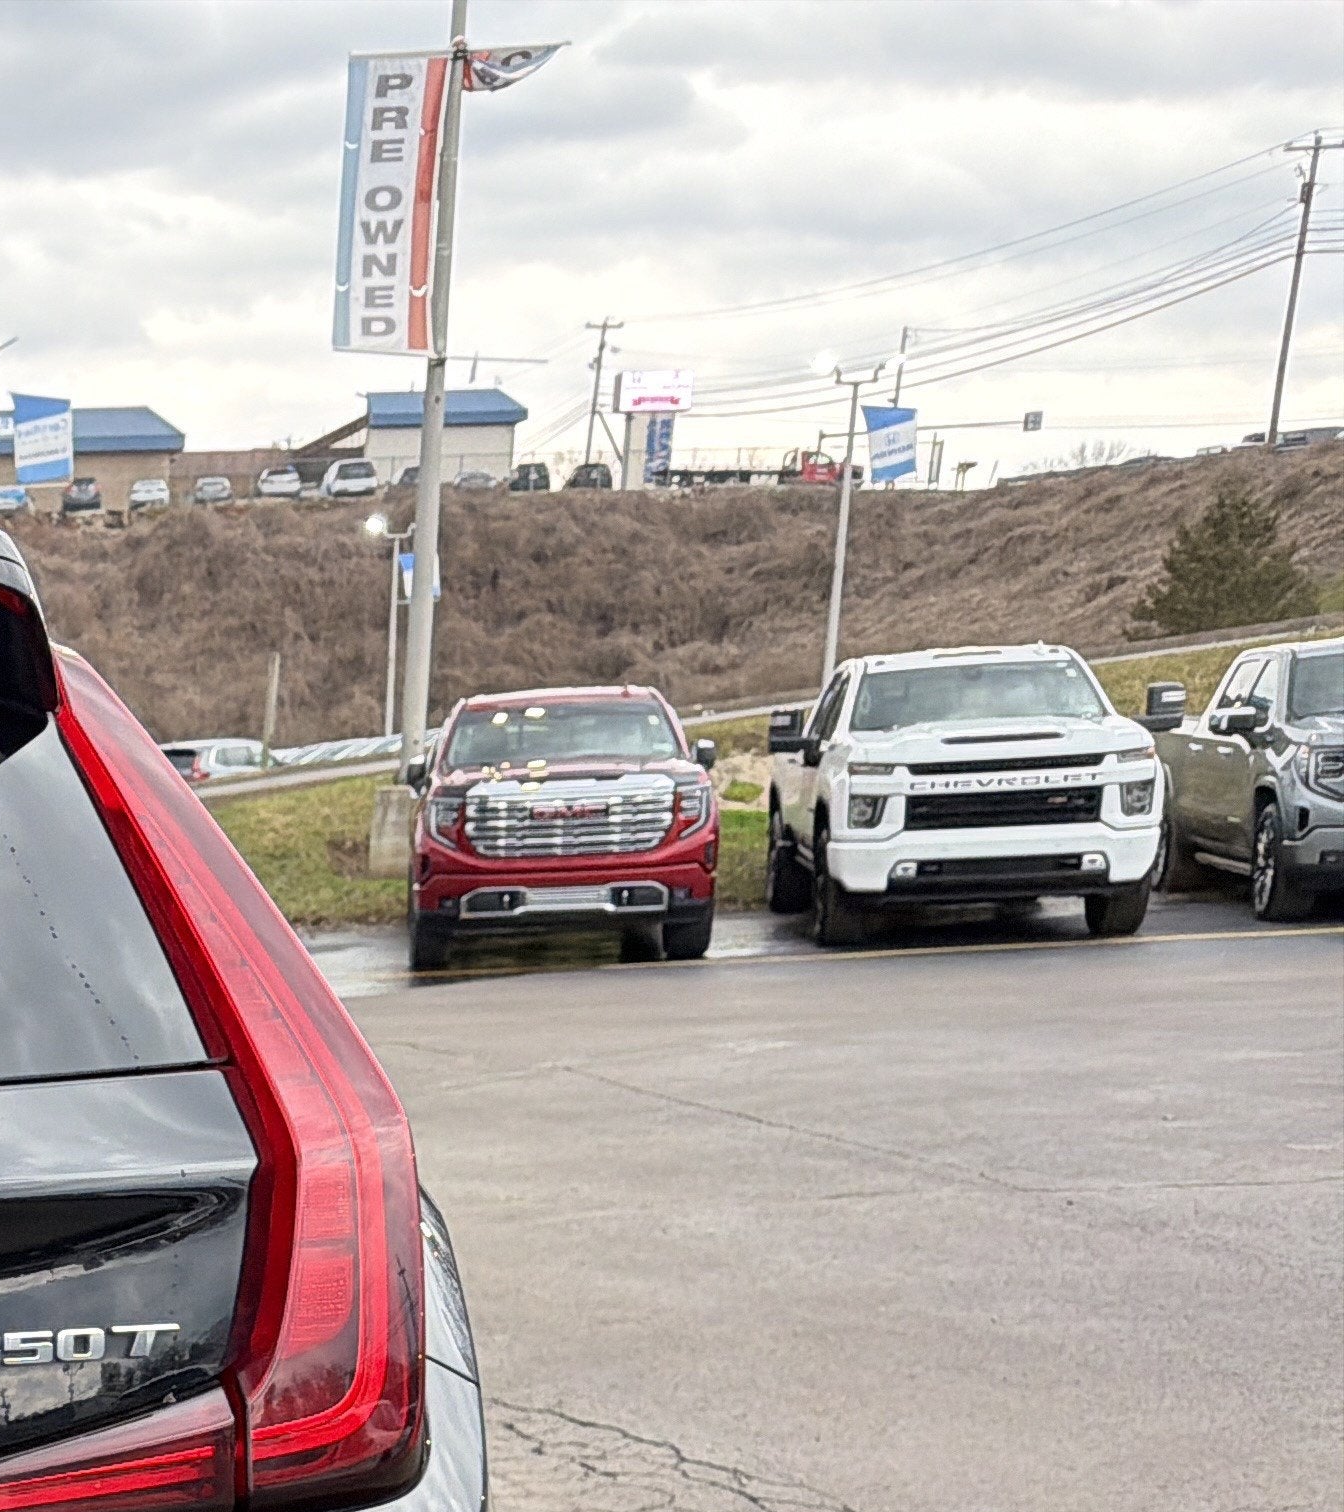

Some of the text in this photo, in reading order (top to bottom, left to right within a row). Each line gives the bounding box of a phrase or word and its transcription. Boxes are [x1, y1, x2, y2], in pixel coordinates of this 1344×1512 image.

[359, 72, 415, 338] PRE OWNED
[909, 771, 1104, 792] CHEVROLET
